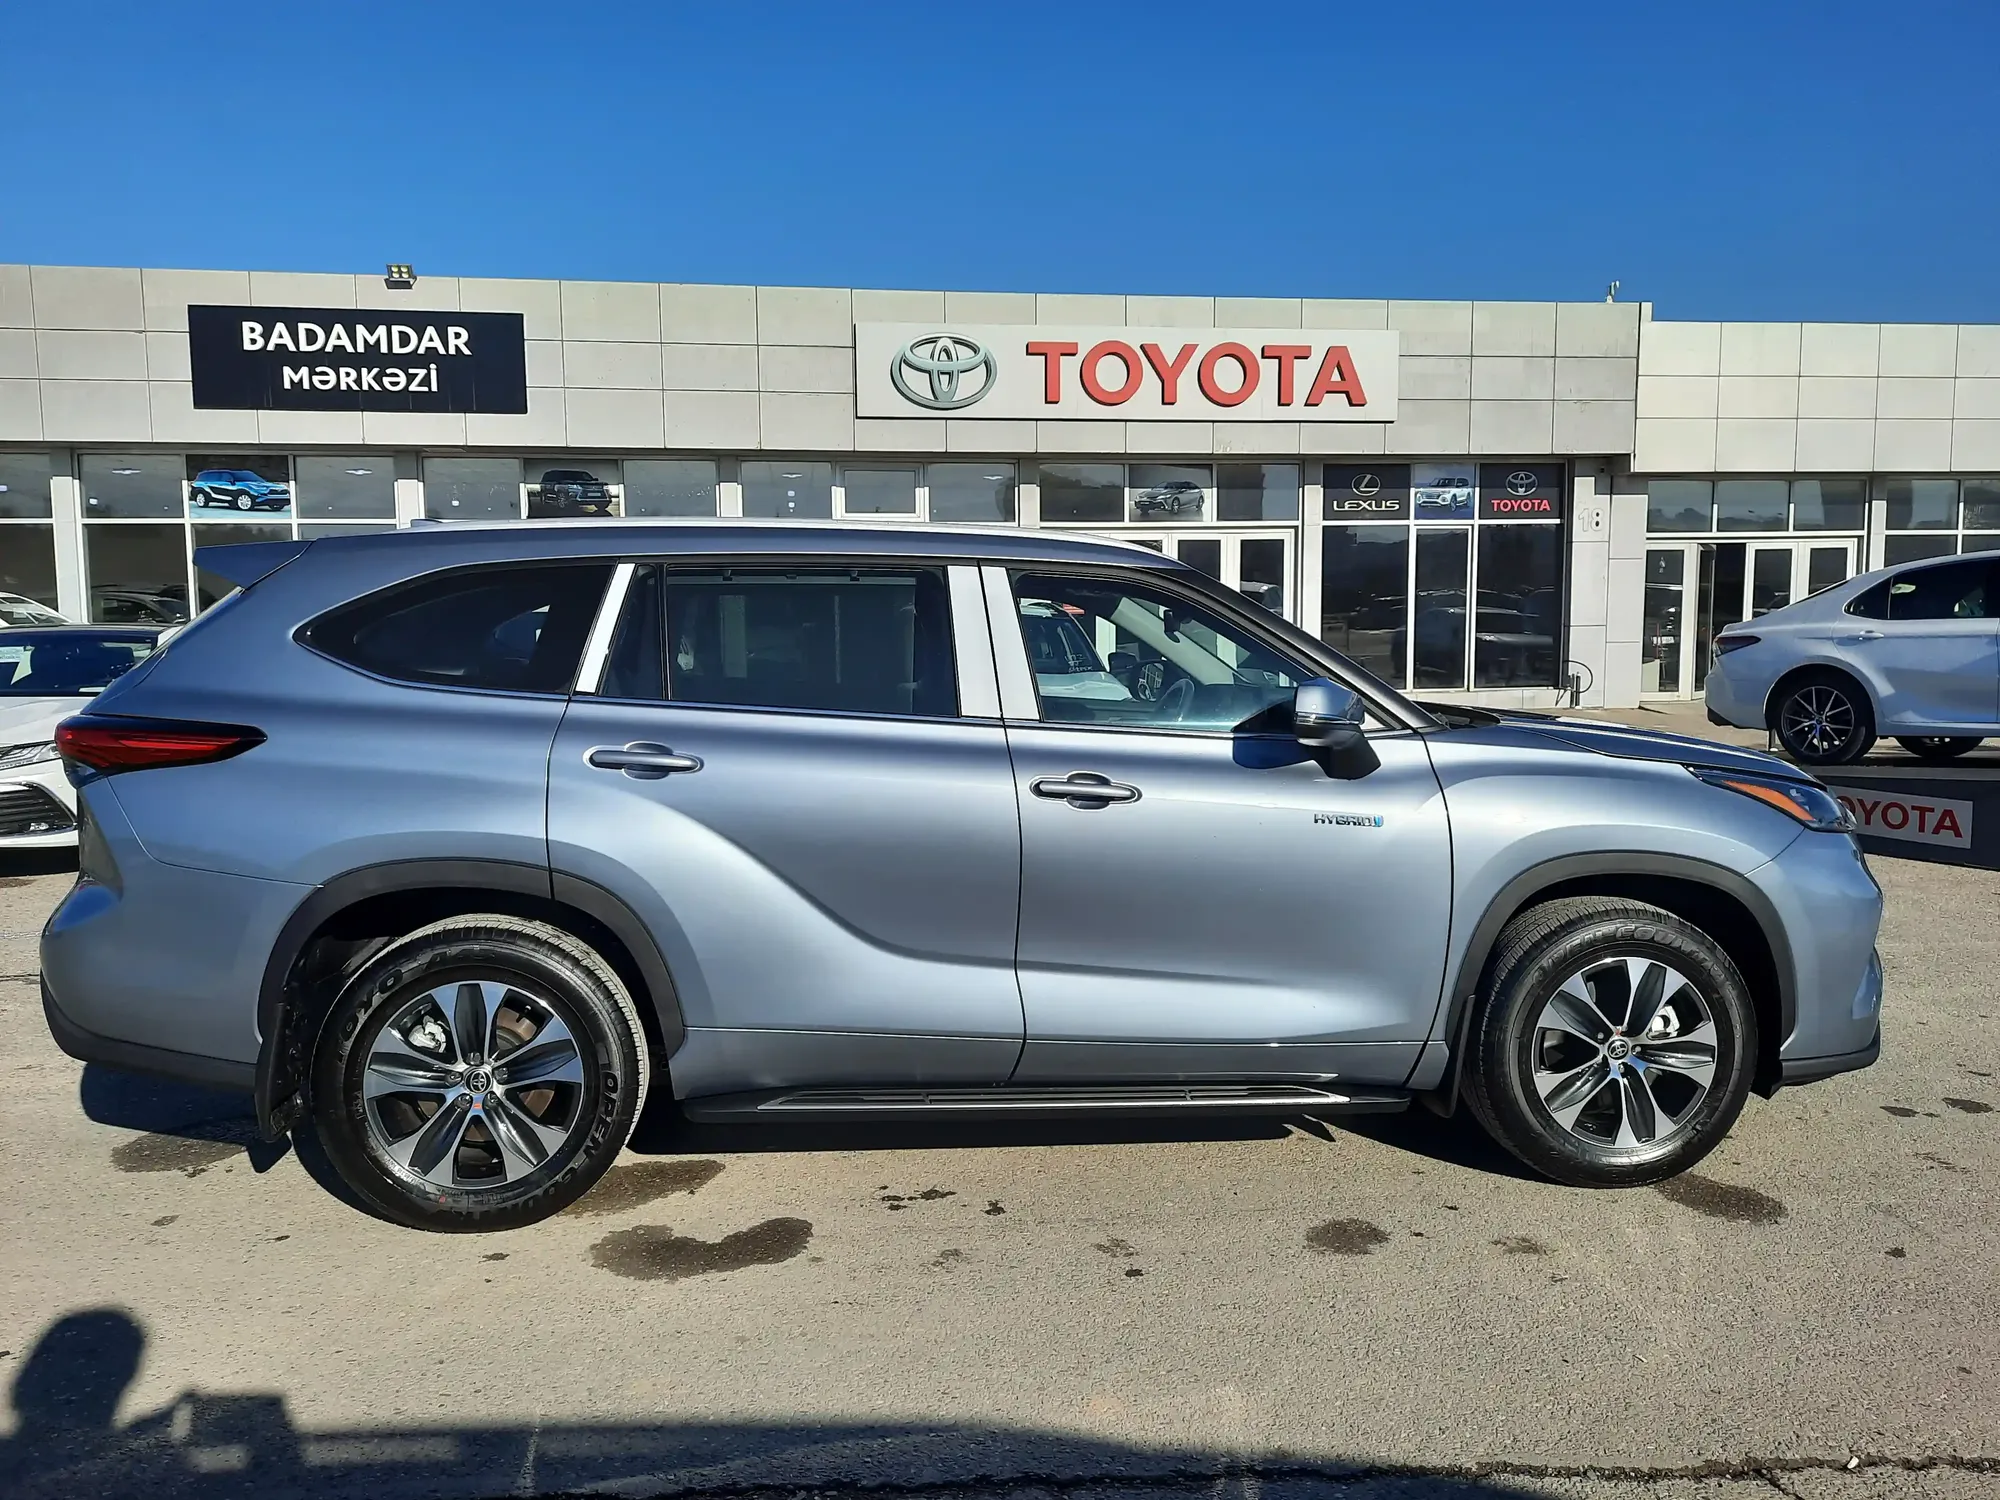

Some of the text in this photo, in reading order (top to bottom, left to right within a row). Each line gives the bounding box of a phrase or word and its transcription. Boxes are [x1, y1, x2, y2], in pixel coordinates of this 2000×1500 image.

[241, 321, 472, 355] BADAMDAR
[1026, 340, 1367, 407] TOYOTA
[1333, 500, 1400, 511] LEXUS
[1491, 500, 1551, 512] TOYOTA
[1578, 507, 1604, 532] 18
[1313, 813, 1373, 827] HYBRID
[1836, 795, 1963, 838] YOTA
